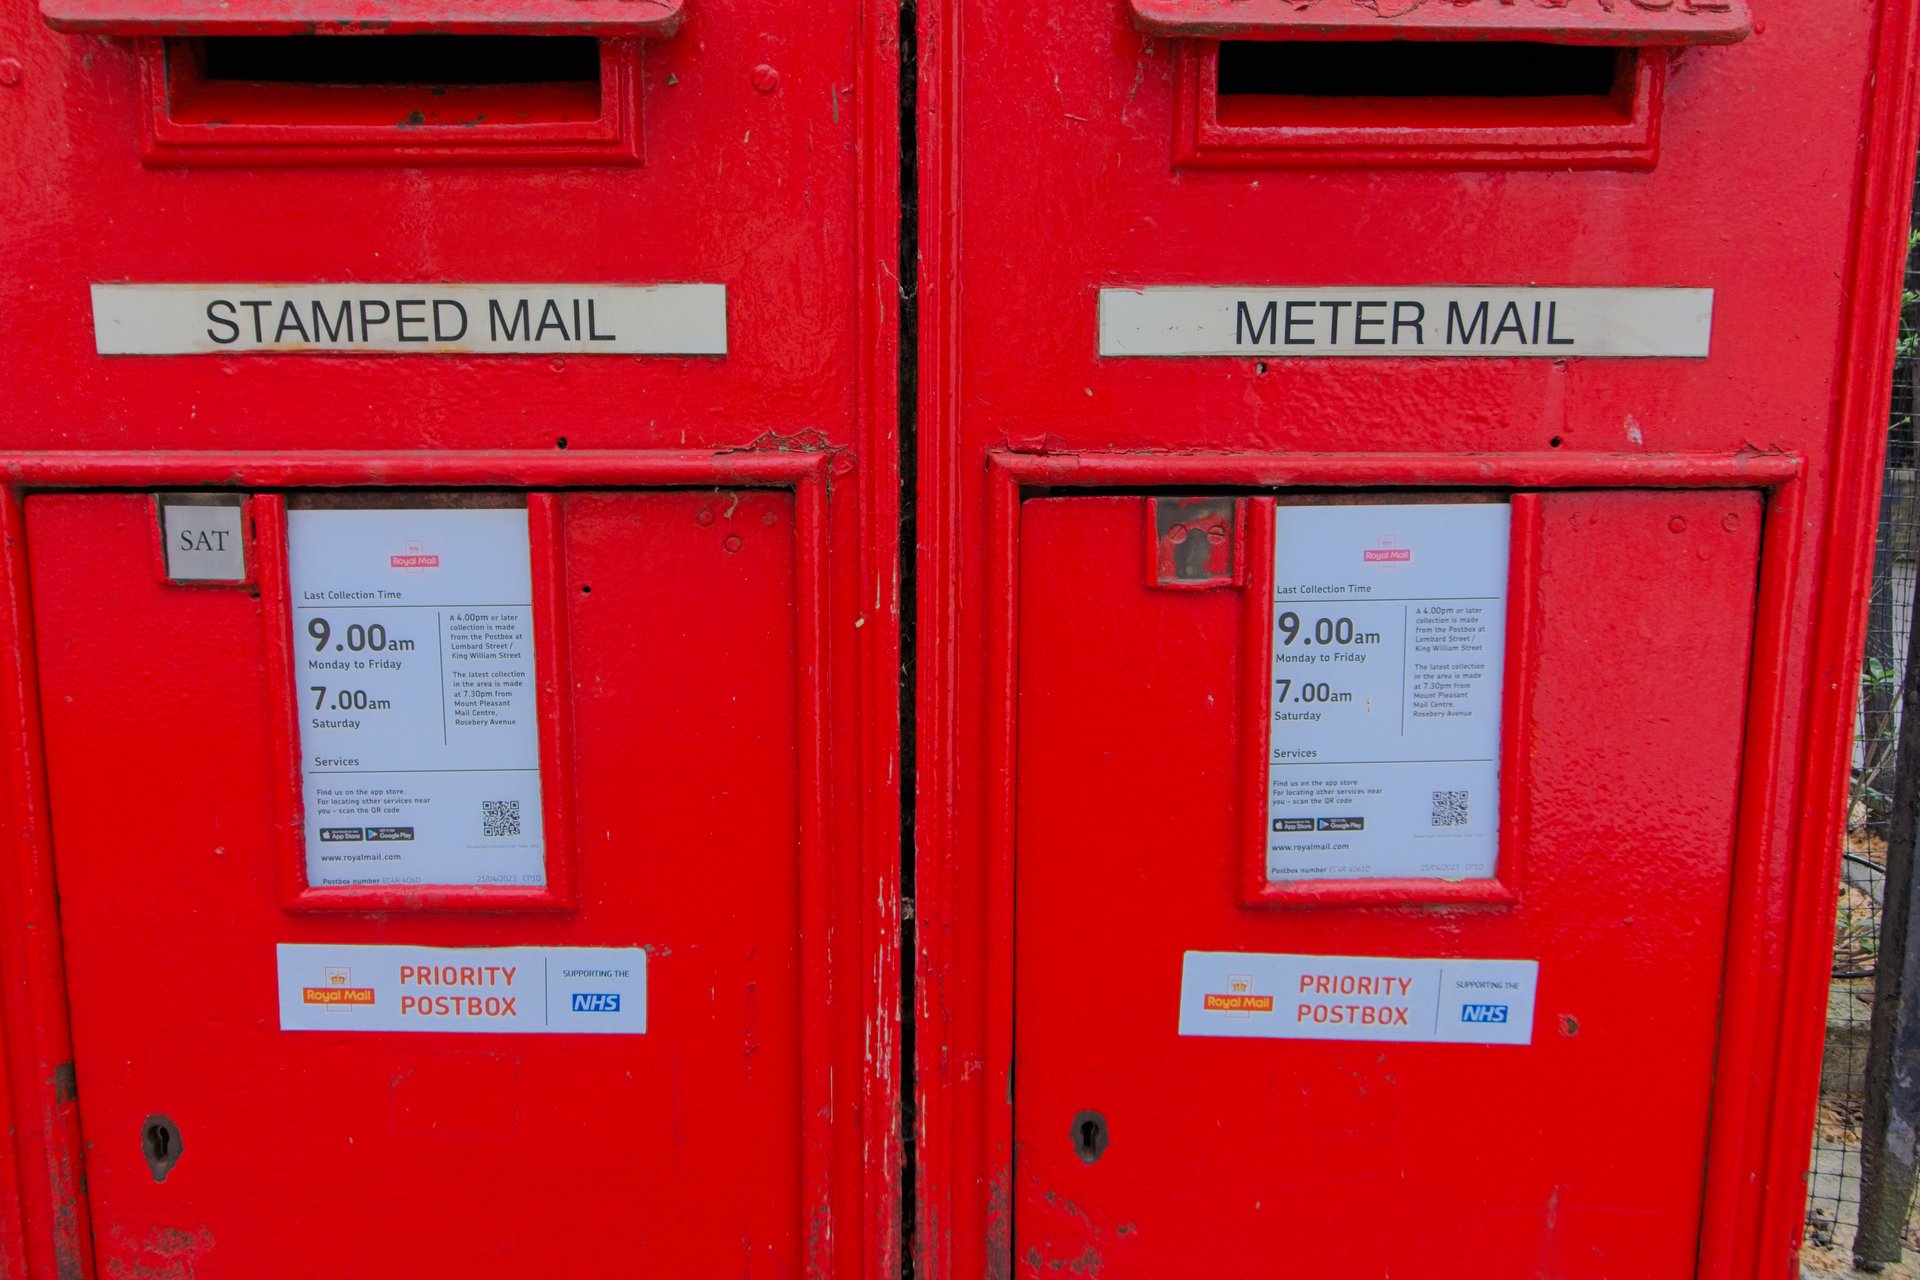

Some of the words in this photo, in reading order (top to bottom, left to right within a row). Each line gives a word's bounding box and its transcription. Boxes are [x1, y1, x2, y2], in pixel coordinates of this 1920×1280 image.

[206, 299, 468, 343] STAMPED
[489, 299, 616, 341] MAIL
[1236, 301, 1424, 344] METER
[1447, 301, 1574, 344] MAIL
[181, 531, 229, 551] SAT
[393, 557, 416, 566] Royal
[418, 556, 436, 565] Mail
[1366, 551, 1388, 561] Royal
[1390, 551, 1408, 559] Mail
[1278, 585, 1297, 595] Last
[1300, 584, 1345, 594] Collection
[1348, 583, 1371, 593] Time
[304, 591, 324, 600] Last
[328, 590, 374, 600] Collection
[377, 589, 401, 599] Time
[1423, 606, 1454, 616] 4.00pm
[450, 614, 454, 622] A
[457, 613, 488, 623] 4.00pm
[1416, 616, 1449, 625] collection
[1460, 616, 1478, 624] made
[450, 623, 484, 632] collection
[487, 623, 493, 631] is
[495, 623, 515, 631] made
[1278, 612, 1380, 645] 9.00am
[1416, 626, 1432, 634] from
[1435, 626, 1446, 634] the
[1449, 625, 1476, 633] Postbox
[308, 618, 414, 652] 9.00am
[451, 632, 469, 642] from
[470, 633, 482, 641] the
[485, 632, 513, 640] Postbox
[1416, 635, 1446, 643] Lombard
[1449, 635, 1470, 643] Street
[451, 642, 483, 650] Lombard
[486, 642, 507, 650] Street
[1415, 645, 1431, 654] King
[1432, 644, 1458, 652] William
[1461, 644, 1482, 652] Street
[452, 652, 468, 661] King
[469, 651, 496, 659] William
[499, 651, 521, 659] Street
[1276, 654, 1316, 664] Monday
[1320, 653, 1330, 663] to
[1335, 652, 1366, 663] Friday
[309, 660, 350, 671] Monday
[354, 660, 364, 669] to
[369, 660, 401, 670] Friday
[1415, 663, 1427, 671] The
[1430, 663, 1449, 671] latest
[1452, 662, 1484, 671] collection
[491, 670, 525, 678] collection
[1423, 672, 1435, 680] the
[462, 680, 474, 688] the
[495, 679, 500, 688] is
[503, 679, 522, 687] made
[1424, 681, 1451, 690] 7.30pm
[1454, 681, 1470, 689] from
[464, 689, 492, 699] 7.30pm
[495, 690, 512, 698] from
[1276, 679, 1351, 703] 7.00am
[1438, 691, 1468, 699] Pleasant
[311, 686, 390, 710] 7.00am
[480, 699, 510, 707] Pleasant
[1413, 701, 1428, 709] Mail
[1431, 700, 1455, 709] Centre,
[455, 709, 469, 717] Mail
[472, 709, 497, 717] Centre,
[1275, 711, 1321, 721] Saturday
[1413, 710, 1445, 719] Rosebery
[1447, 709, 1472, 717] Avenue
[312, 719, 360, 729] Saturday
[455, 718, 488, 727] Rosebery
[490, 718, 516, 726] Avenue
[1274, 749, 1317, 758] Services
[315, 757, 359, 766] Services
[1273, 779, 1288, 787] Find
[1312, 779, 1323, 787] the
[1325, 780, 1338, 789] app
[317, 788, 332, 796] Find
[355, 788, 368, 796] the
[1273, 788, 1284, 797] For
[1286, 789, 1313, 797] locating
[1316, 788, 1334, 796] other
[1337, 787, 1365, 795] services
[317, 798, 329, 806] For
[331, 797, 359, 806] locating
[362, 797, 380, 805] other
[383, 796, 412, 805] services
[1272, 799, 1285, 807] you
[1311, 797, 1322, 805] the
[1325, 797, 1334, 805] QR
[318, 808, 330, 816] you
[371, 806, 381, 814] QR
[384, 806, 400, 814] code
[332, 833, 343, 841] App
[345, 832, 360, 840] Store
[380, 832, 399, 840] Google
[400, 832, 411, 840] Play
[1272, 843, 1349, 852] www.royalmail.com
[321, 853, 401, 862] www.royalmail.com
[1272, 866, 1298, 875] Postbox
[1301, 866, 1326, 874] number
[322, 878, 350, 886] Postbox
[401, 966, 516, 985] PRIORITY
[563, 969, 612, 978] SUPPORTING
[614, 969, 629, 978] THE
[1300, 975, 1411, 995] PRIORITY
[1456, 980, 1503, 990] SUPPORTING
[1505, 981, 1519, 990] THE
[307, 989, 342, 1002] Royal
[344, 989, 371, 1000] Mail
[402, 996, 516, 1016] POSTBOX
[574, 995, 618, 1011] NHS
[1207, 996, 1241, 1009] Royal
[1244, 997, 1270, 1008] Mail
[1298, 1004, 1408, 1025] POSTBOX
[1463, 1006, 1505, 1022] NHS
